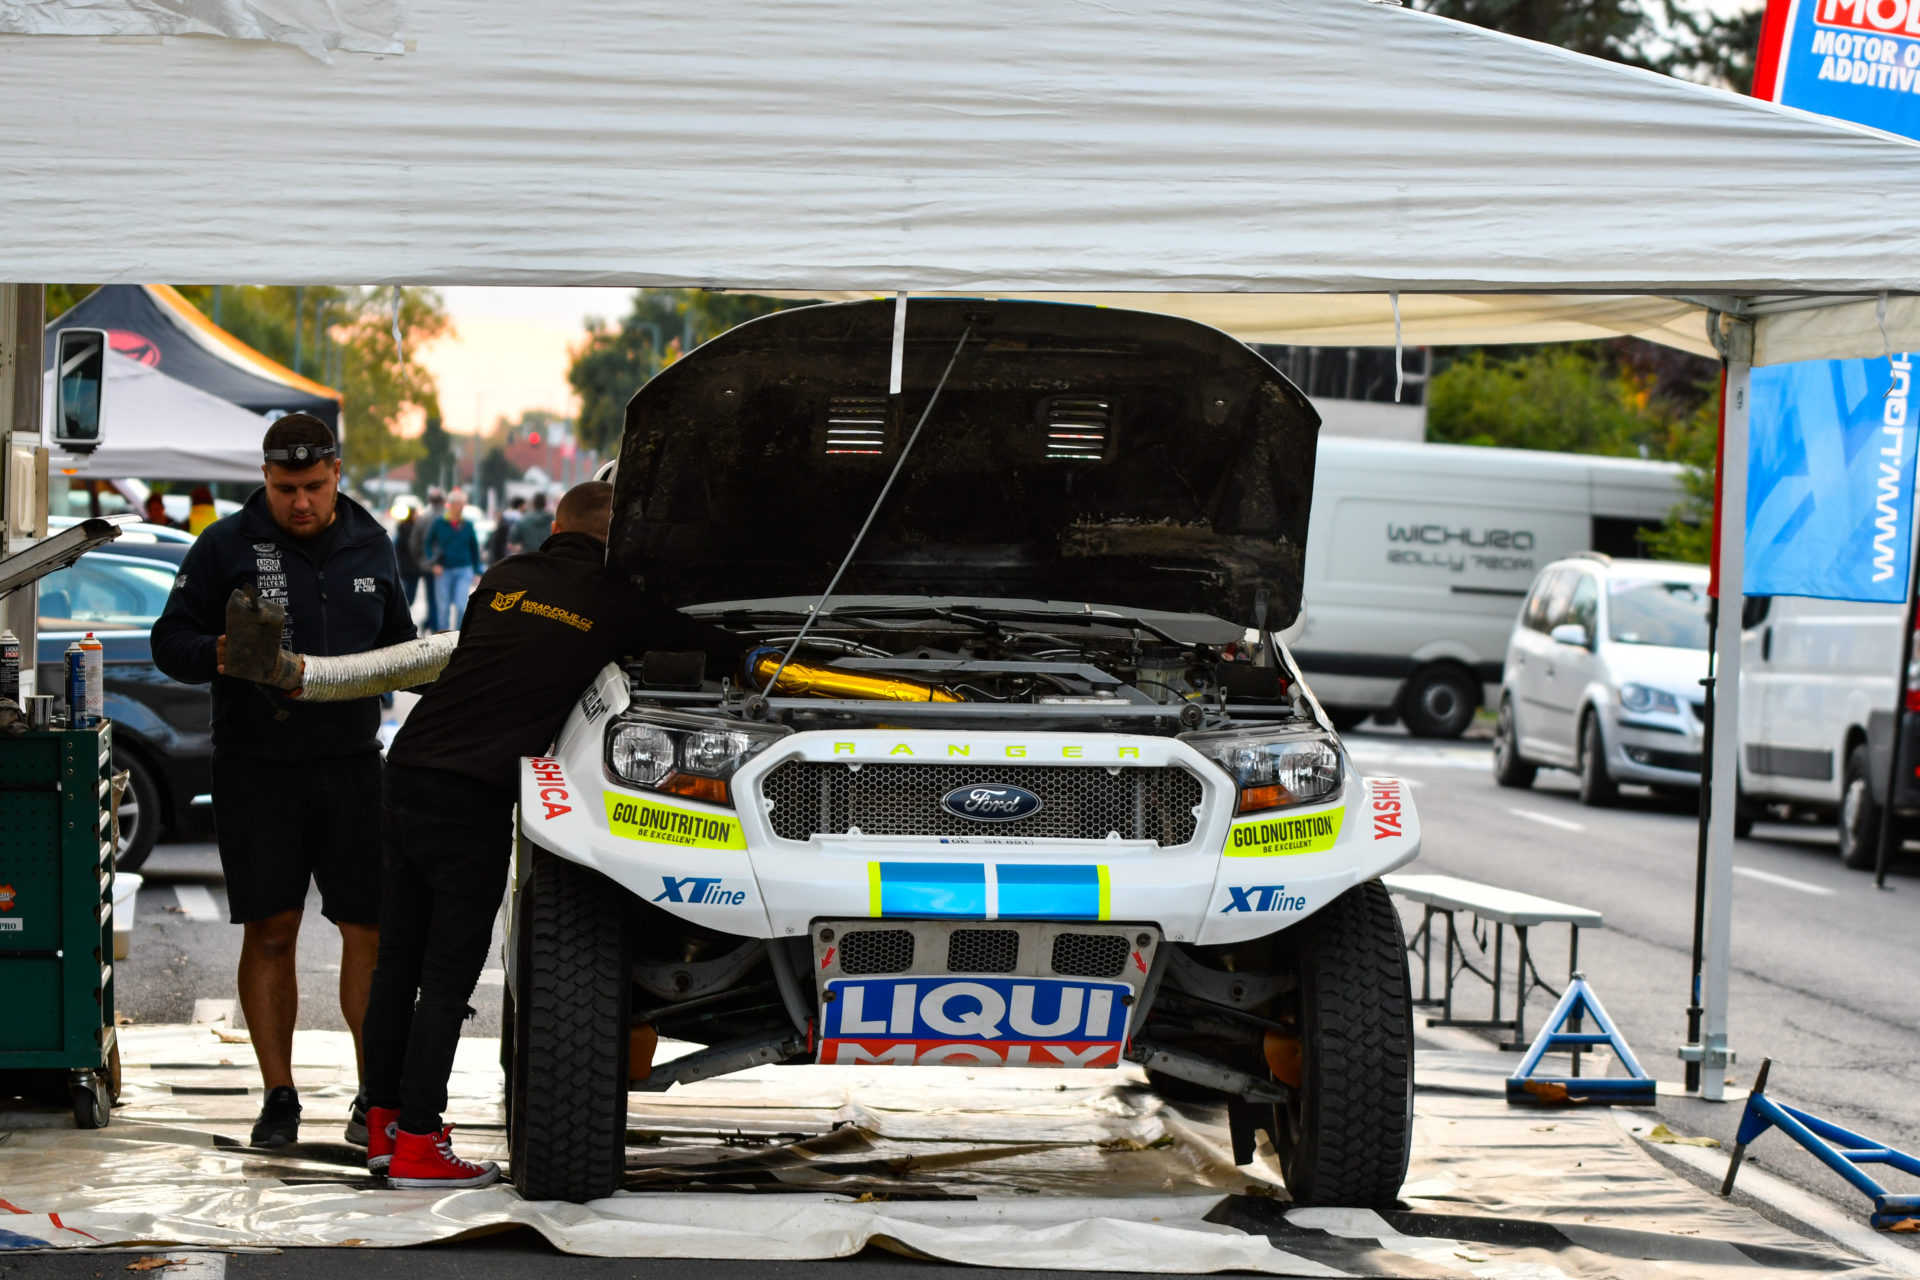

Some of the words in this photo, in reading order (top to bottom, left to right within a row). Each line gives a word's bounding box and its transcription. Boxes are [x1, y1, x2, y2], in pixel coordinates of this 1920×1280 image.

[1811, 30, 1898, 65] MOTOR
[259, 588, 288, 598] XTline
[521, 599, 594, 626] WRAP-FOLIE.CZ
[833, 742, 1139, 759] RANGER
[964, 788, 1019, 814] Ford
[613, 803, 731, 843] GOLDNUTRITION
[638, 828, 648, 836] BE
[650, 830, 697, 845] EXCELLENT
[1233, 817, 1333, 848] GOLDNUTRITION
[1274, 840, 1312, 852] EXCELLENT
[652, 876, 746, 905] XTline
[1220, 885, 1306, 913] XTline
[839, 981, 1114, 1039] LIQUI
